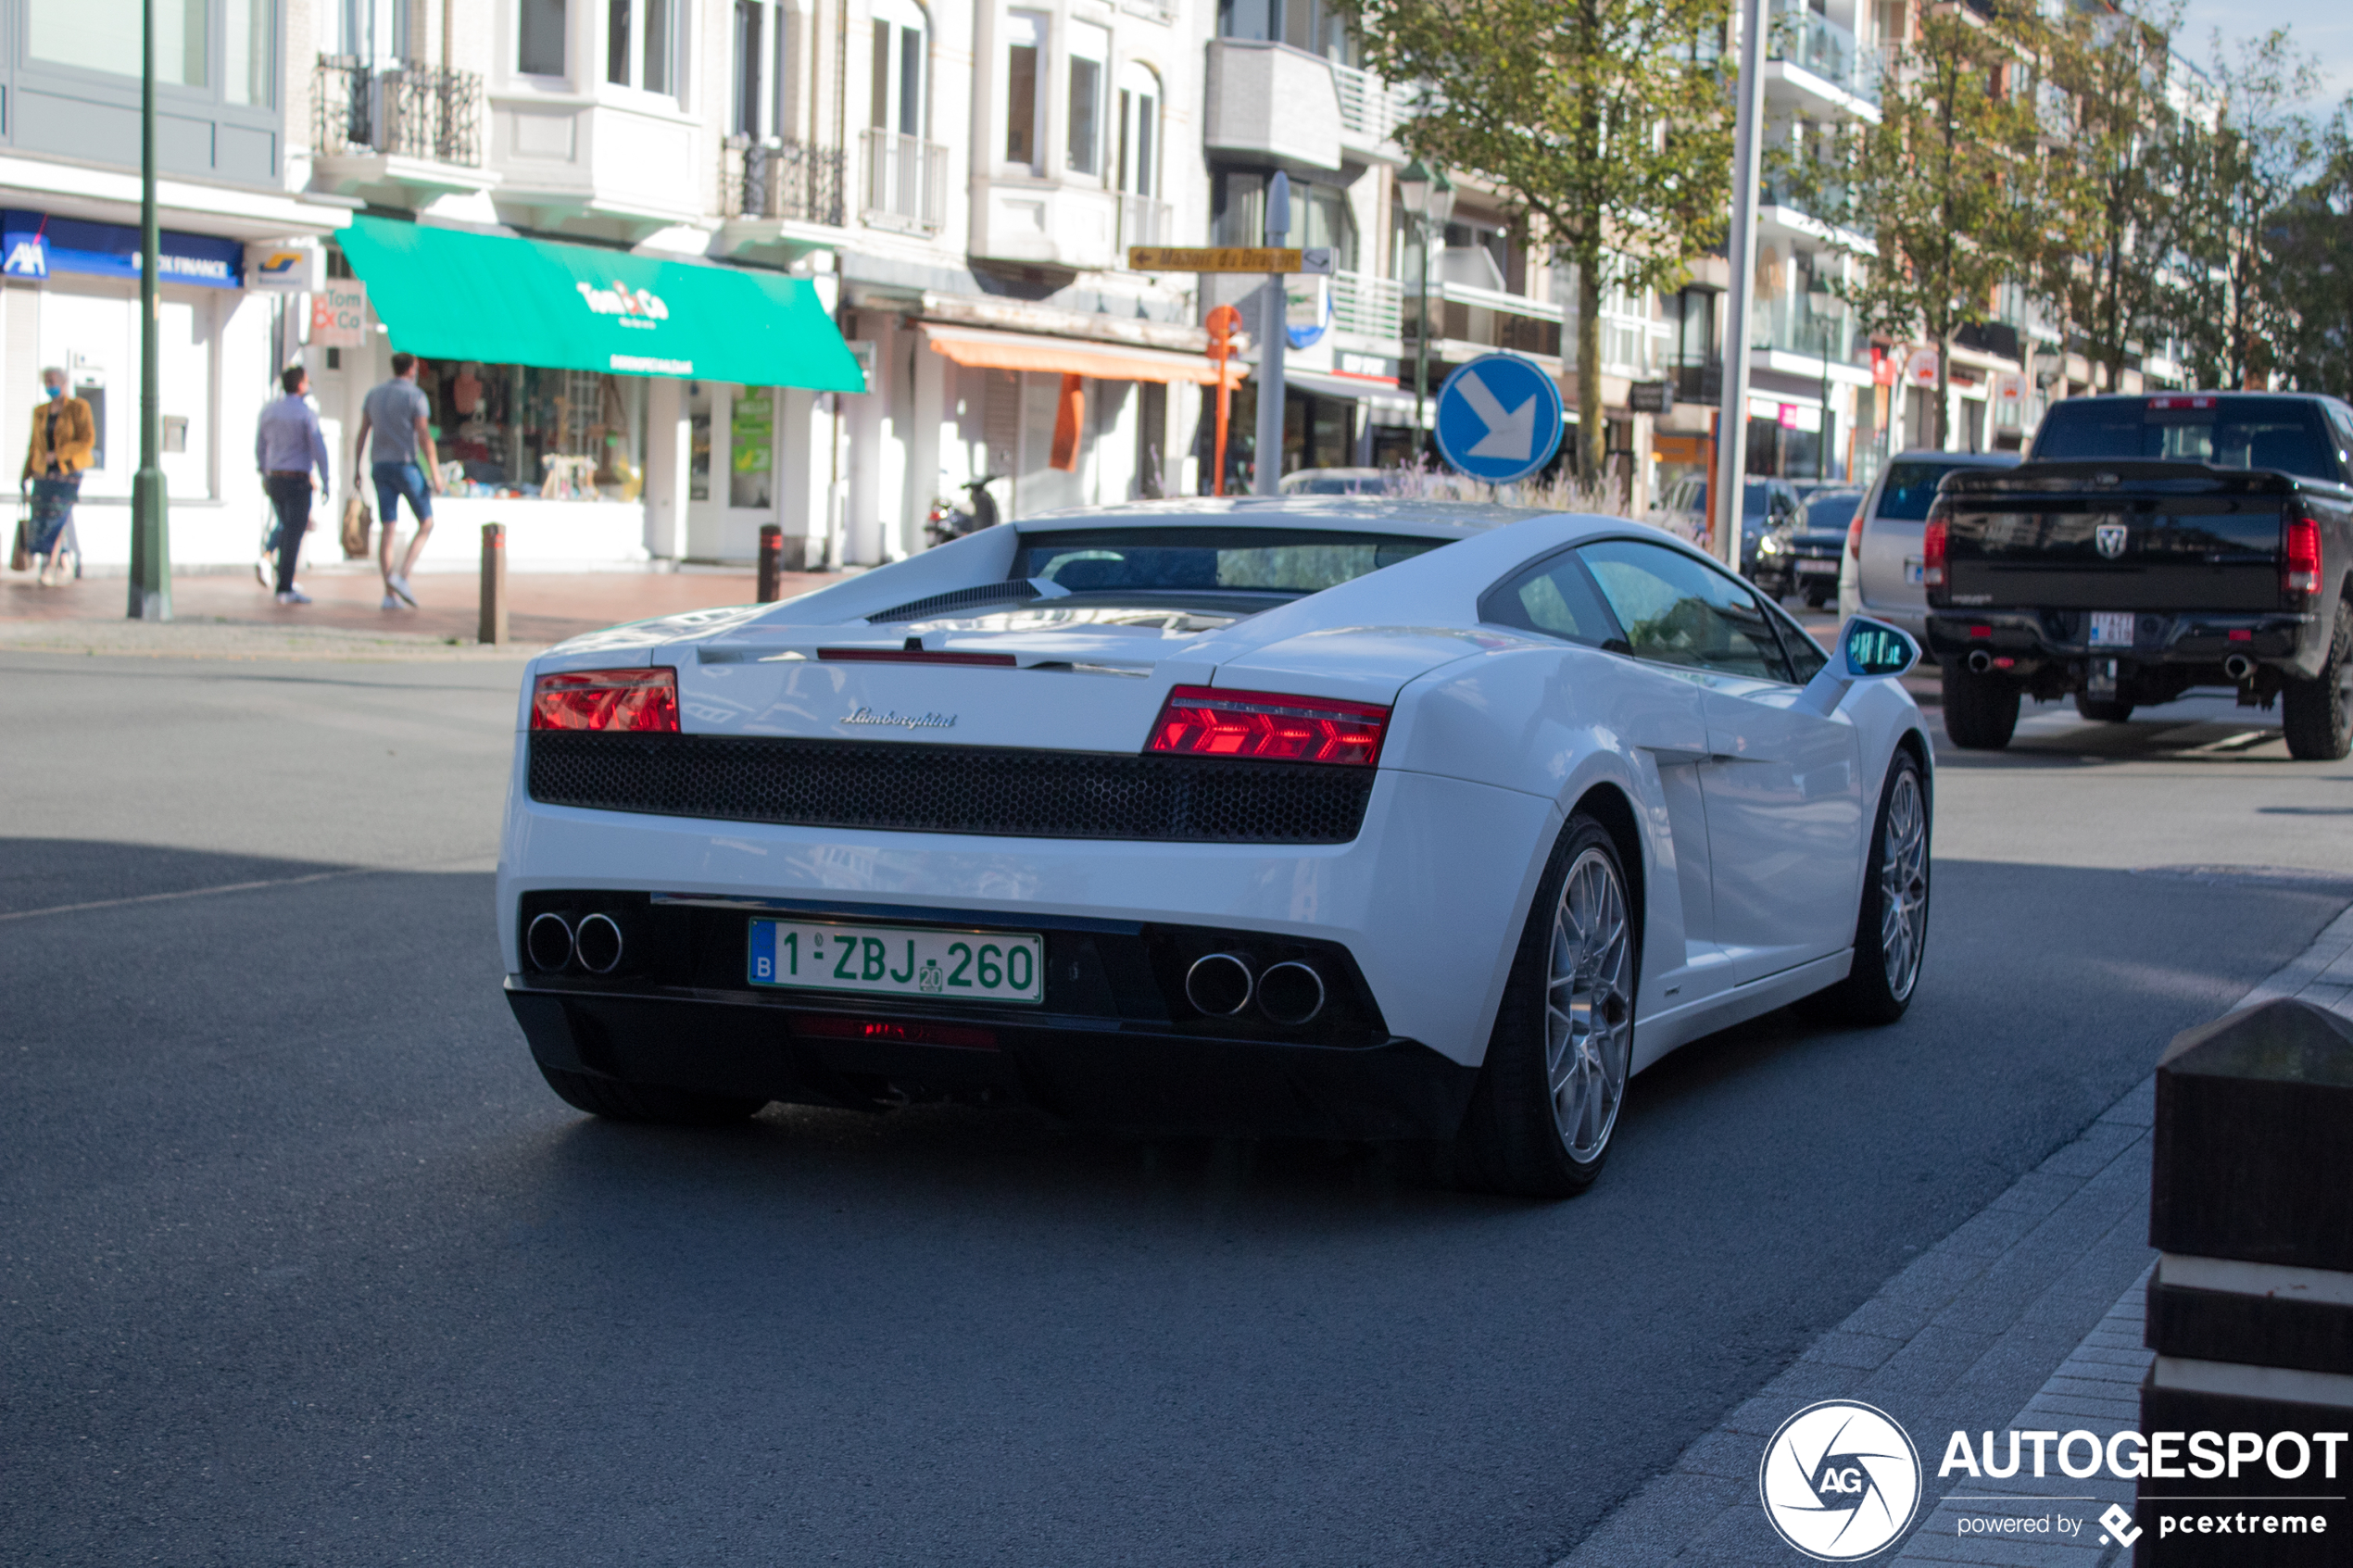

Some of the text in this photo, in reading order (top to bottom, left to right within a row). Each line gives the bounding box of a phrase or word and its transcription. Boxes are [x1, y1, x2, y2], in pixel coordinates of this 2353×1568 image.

[4, 242, 46, 277] AXA
[174, 255, 228, 280] FINANCE
[327, 289, 360, 307] Tom
[840, 707, 957, 730] Lamborghini
[757, 957, 771, 977] B
